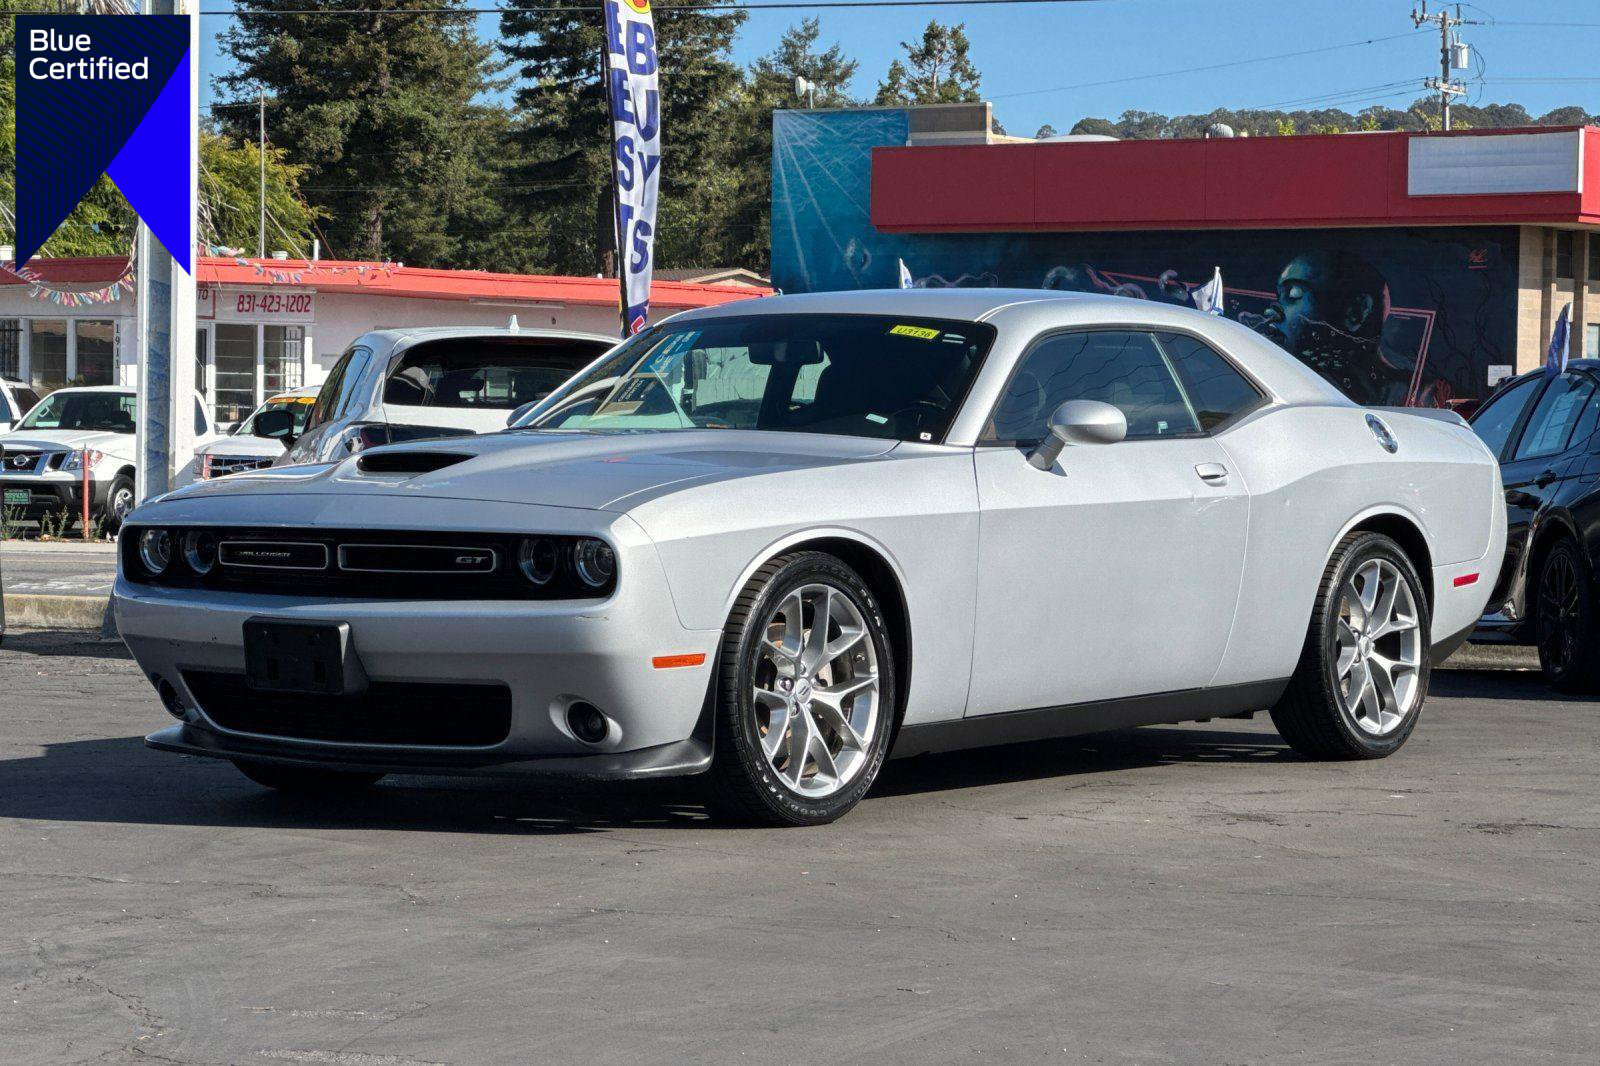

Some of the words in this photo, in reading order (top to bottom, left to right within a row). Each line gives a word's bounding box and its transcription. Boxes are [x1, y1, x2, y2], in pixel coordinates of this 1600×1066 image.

[626, 20, 660, 274] BUYS
[236, 294, 311, 313] 831-423-1202
[456, 556, 489, 564] GT
